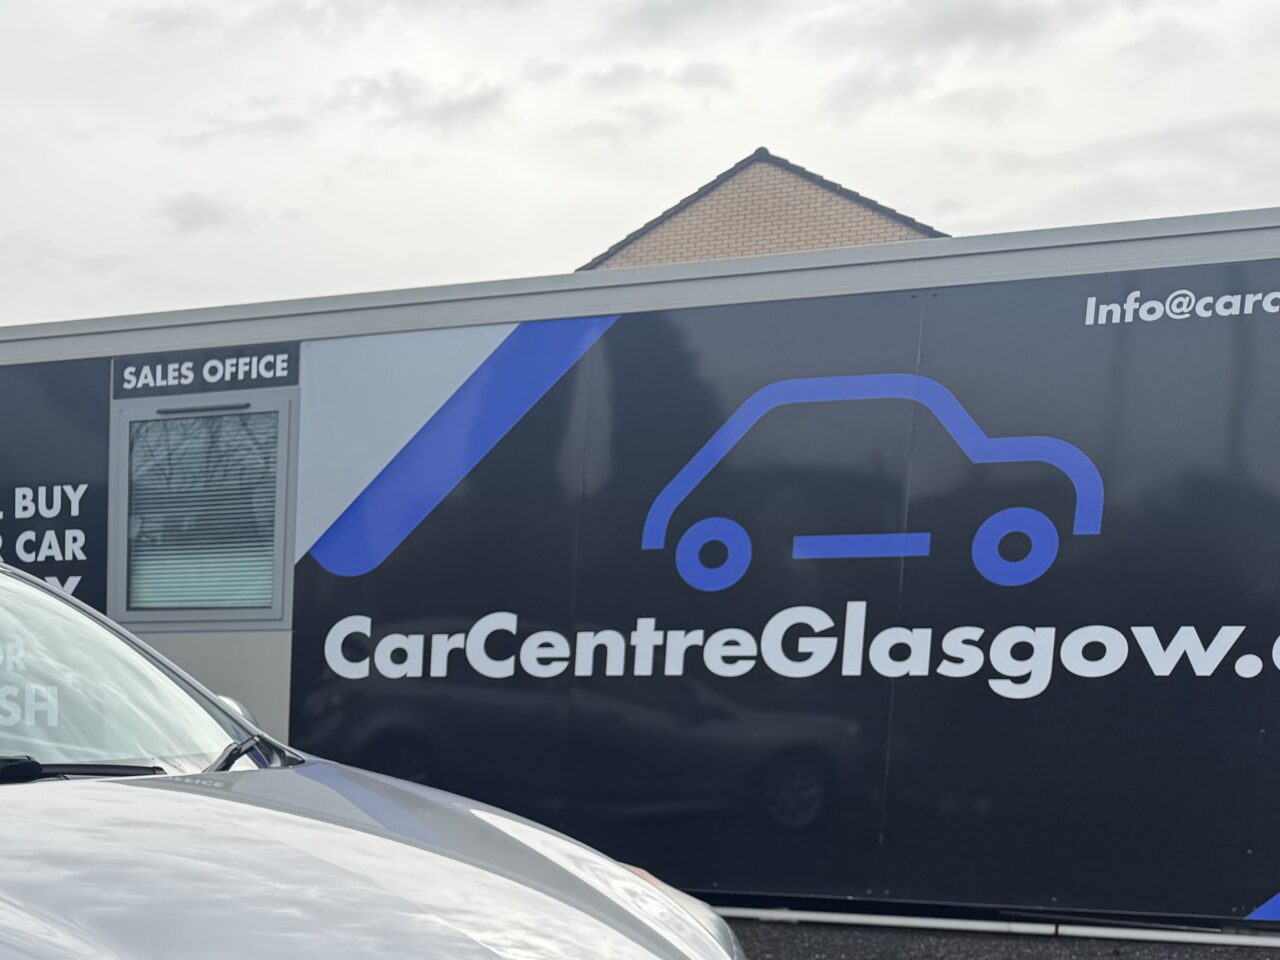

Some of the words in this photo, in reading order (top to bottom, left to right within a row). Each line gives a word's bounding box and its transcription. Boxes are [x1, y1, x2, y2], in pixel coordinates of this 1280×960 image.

[1085, 289, 1280, 325] Info@carc
[122, 361, 195, 390] SALES
[202, 353, 289, 383] OFFICE
[14, 483, 89, 519] BUY
[15, 529, 87, 563] CAR
[323, 601, 1280, 700] CarCentreGlasgow.
